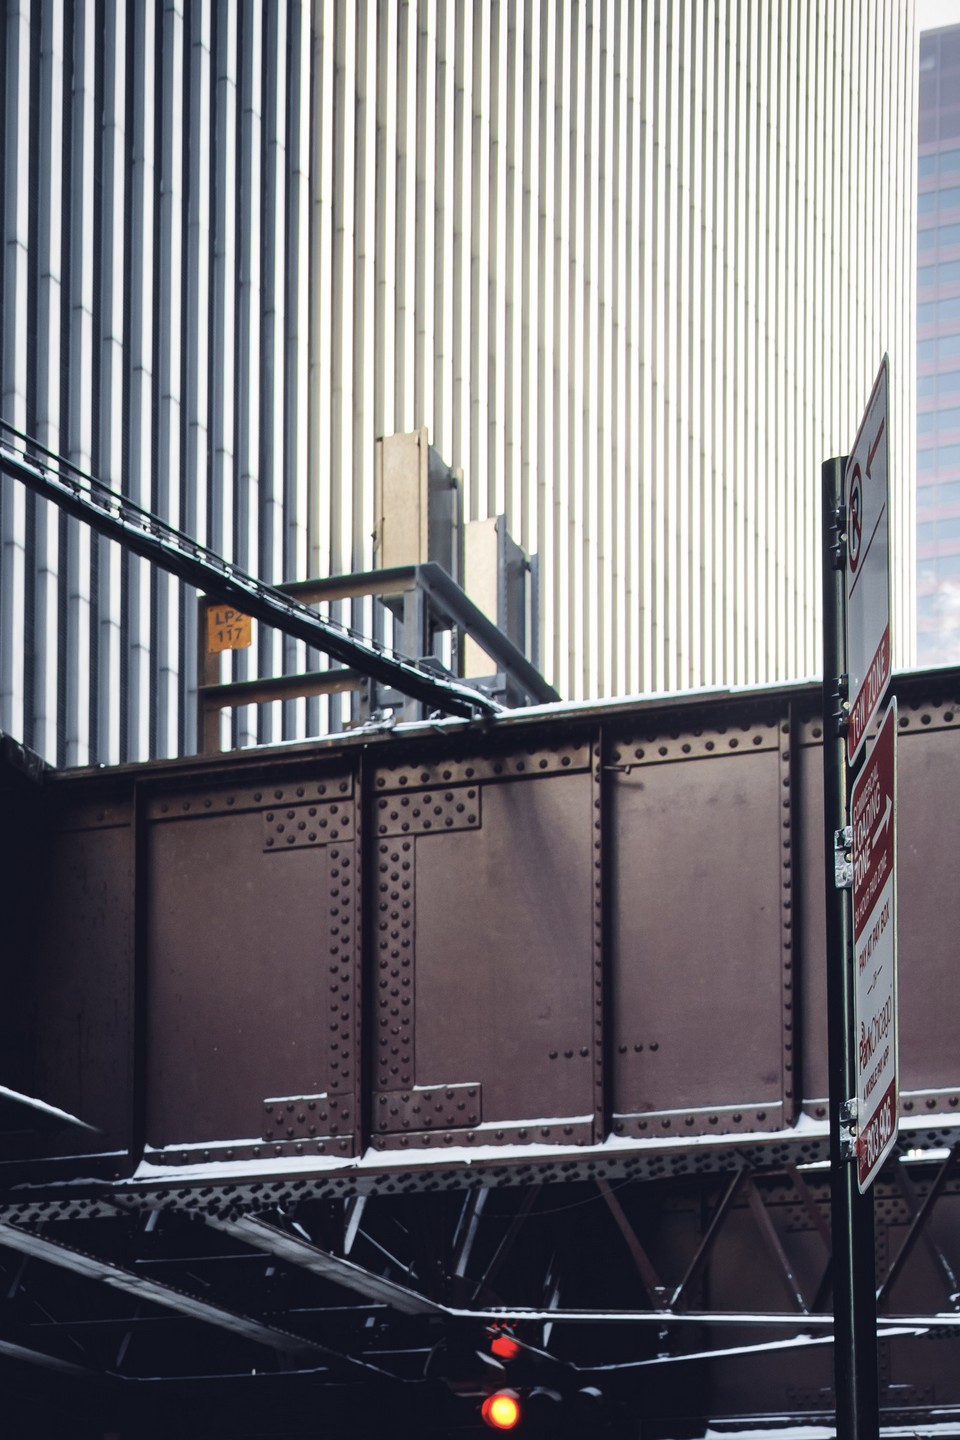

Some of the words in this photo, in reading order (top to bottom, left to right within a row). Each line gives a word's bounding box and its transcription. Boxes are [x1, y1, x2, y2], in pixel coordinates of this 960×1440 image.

[217, 627, 242, 643] 117
[852, 687, 866, 747] TOW
[867, 640, 886, 714] ZONE
[854, 781, 881, 860] LOADING
[854, 836, 871, 894] ZONE
[880, 898, 890, 935] BOX
[859, 995, 891, 1077] ParkChicago
